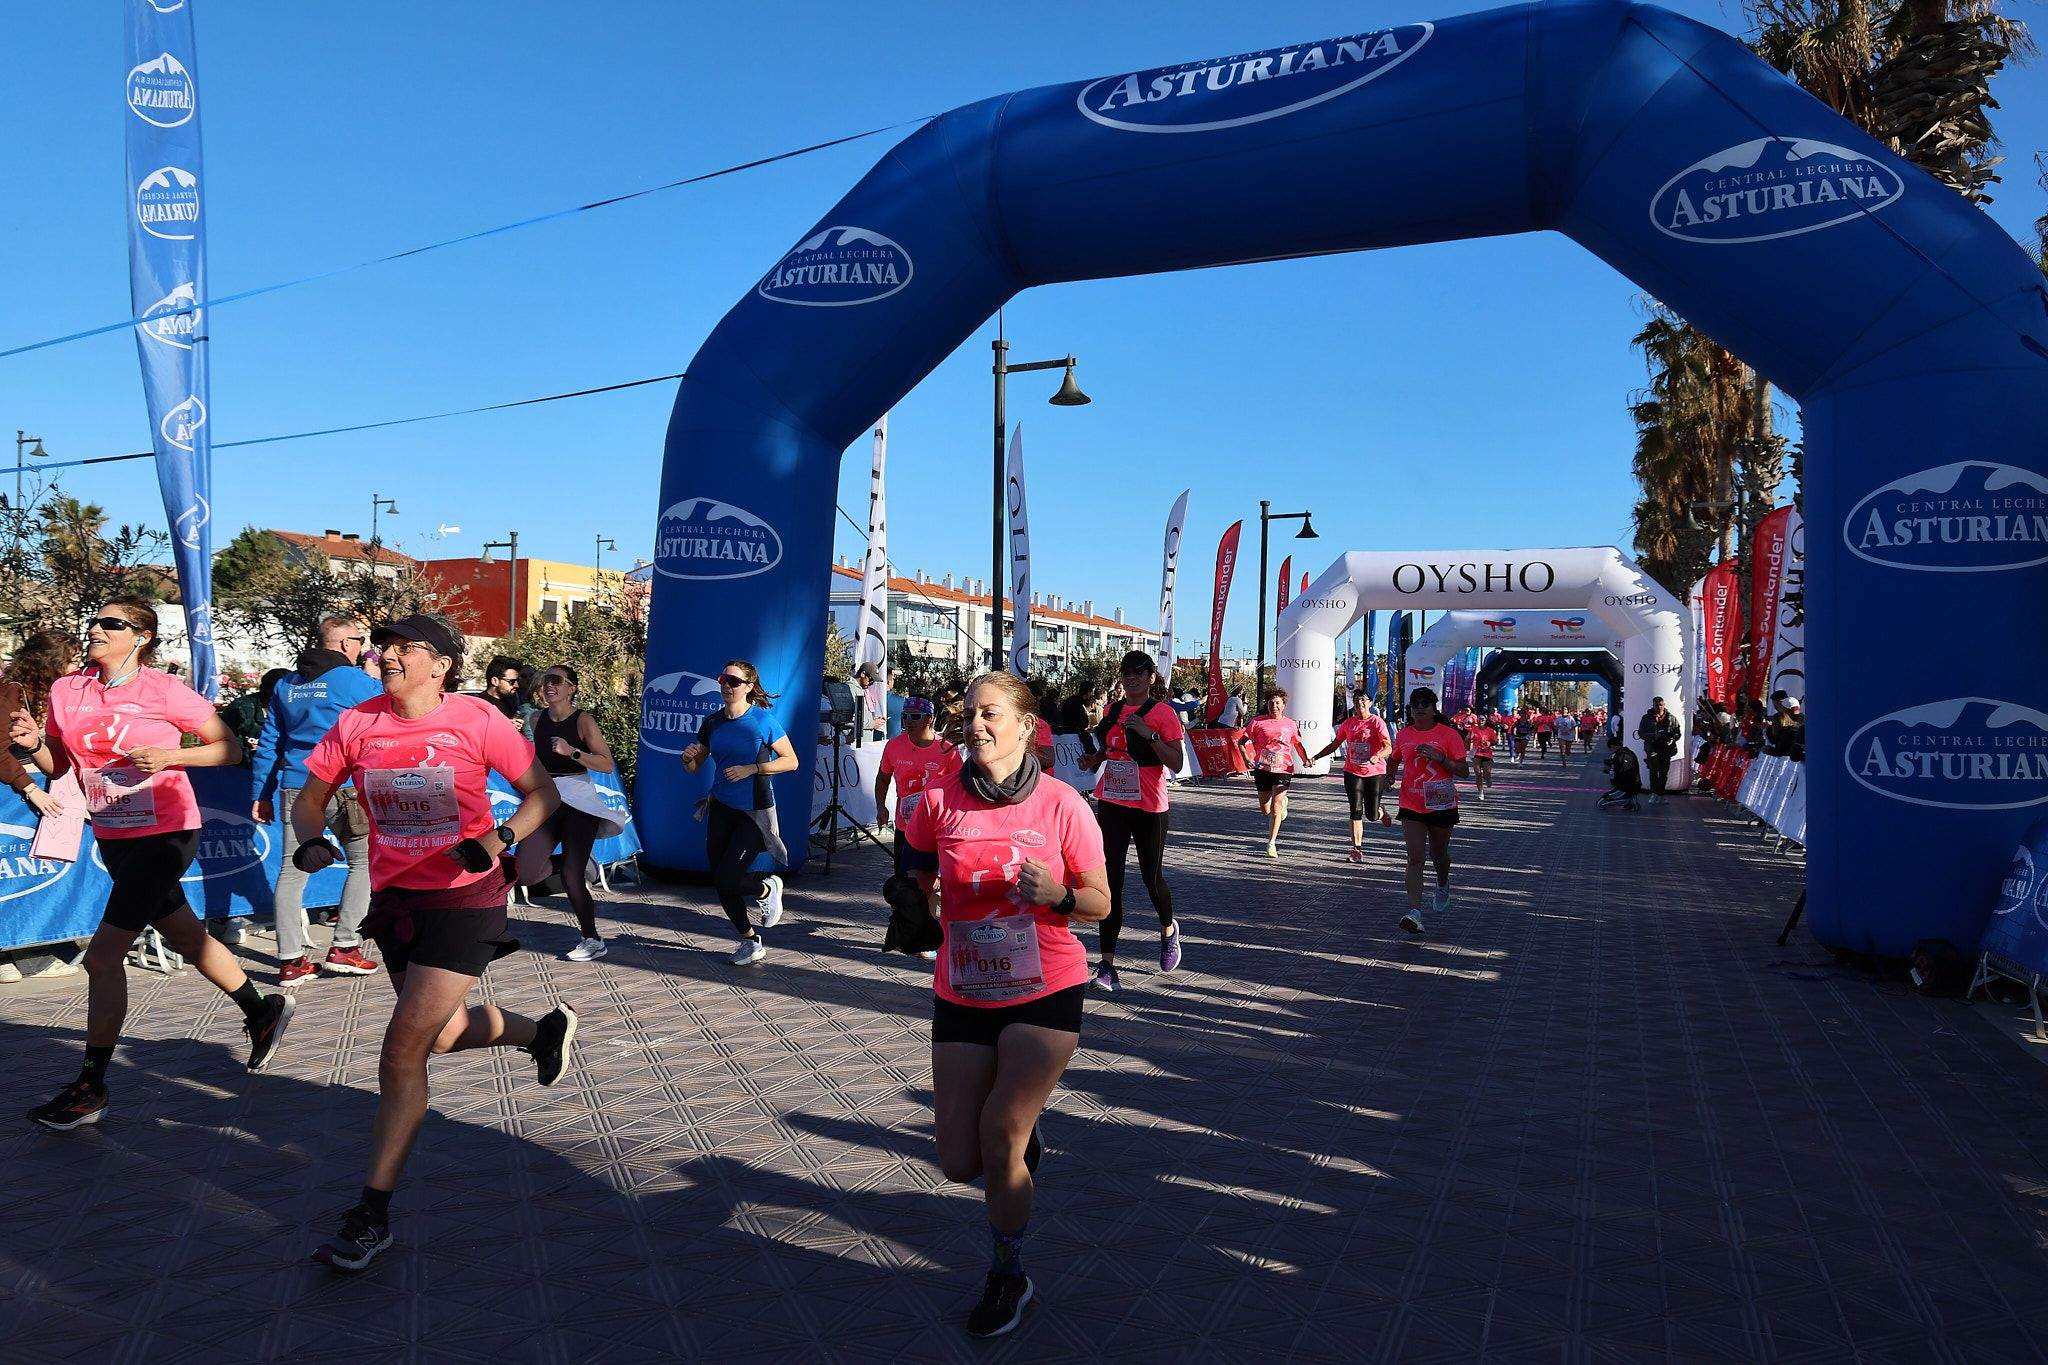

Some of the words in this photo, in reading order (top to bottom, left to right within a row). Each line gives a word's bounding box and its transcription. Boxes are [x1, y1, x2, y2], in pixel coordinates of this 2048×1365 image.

[1098, 32, 1401, 111] ASTURIANA
[1704, 168, 1787, 191] CENTRAL
[1796, 163, 1874, 176] LECHERA
[1669, 176, 1889, 229] ASTURIANA
[790, 252, 836, 265] CENTRAL
[839, 250, 894, 259] LECHERA
[765, 263, 900, 291] ASTURIANA
[1896, 500, 1984, 513] CENTRAL
[665, 525, 705, 534] CENTRAL
[710, 527, 766, 539] LECHERA
[655, 529, 769, 564] ASTURIANA
[1392, 561, 1555, 594] OYSHO
[1760, 533, 1784, 633] Santander
[1213, 548, 1233, 631] Santander
[1301, 599, 1347, 609] OYSHO
[1604, 594, 1657, 606] OYSHO
[1711, 582, 1728, 655] Santander
[1280, 659, 1321, 669] OYSHO
[1518, 658, 1590, 666] VOLVO
[1633, 662, 1682, 674] OYSHO
[650, 699, 689, 708] CENTRAL
[640, 700, 705, 733] ASTURI
[1898, 735, 1985, 746] CENTRAL
[105, 795, 131, 805] 016
[400, 801, 430, 812] 016
[409, 838, 418, 848] DE
[420, 838, 430, 847] LA
[977, 956, 1012, 973] 016
